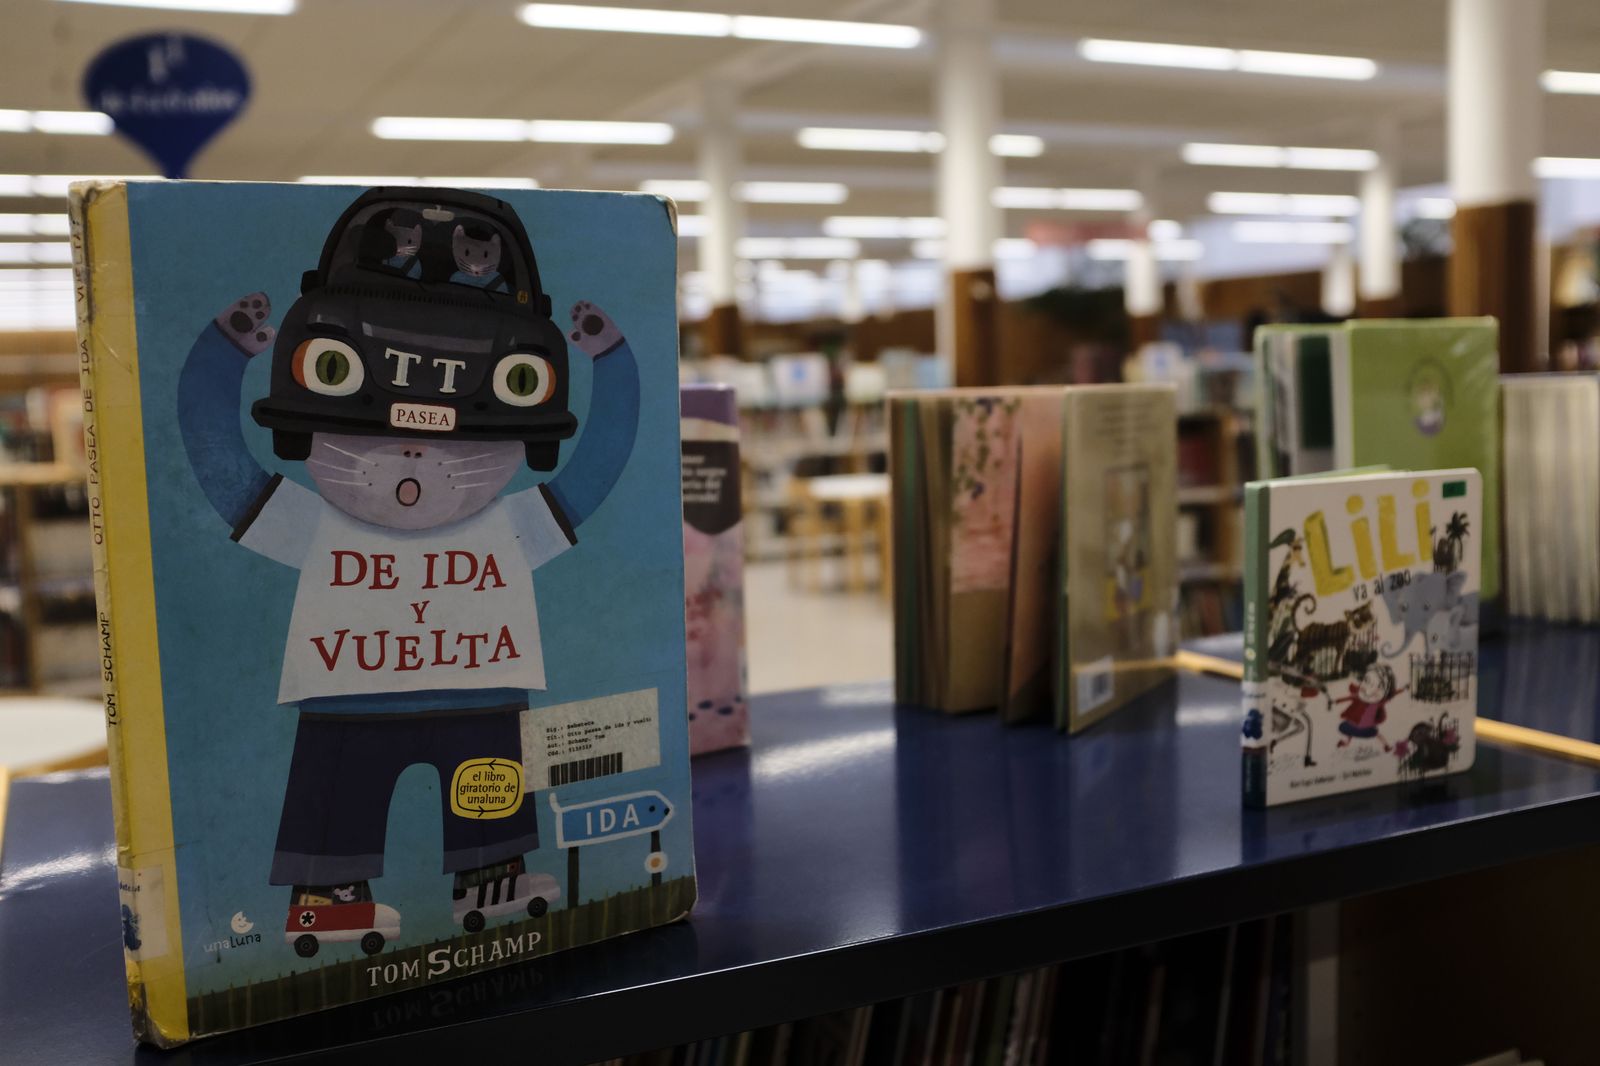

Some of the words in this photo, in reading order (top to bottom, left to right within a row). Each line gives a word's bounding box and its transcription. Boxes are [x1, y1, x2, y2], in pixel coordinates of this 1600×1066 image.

[80, 338, 90, 375] IDA
[83, 389, 93, 412] DE
[396, 408, 451, 427] PASEA
[87, 424, 98, 485] PASEA
[91, 496, 103, 545] OTTO
[330, 550, 399, 590] DE
[421, 550, 507, 591] IDA
[1353, 584, 1368, 602] va
[1373, 572, 1385, 596] al
[410, 600, 430, 624] Y
[100, 612, 114, 682] SCHAMP
[310, 625, 521, 672] VUELTA
[108, 693, 117, 728] TOM
[460, 782, 501, 796] giratorio
[504, 782, 516, 793] de
[472, 771, 481, 782] el
[484, 771, 506, 782] libro
[467, 794, 507, 804] unaluna
[586, 803, 640, 835] IDA
[366, 959, 420, 987] TOM
[427, 931, 542, 980] SCHAMP
